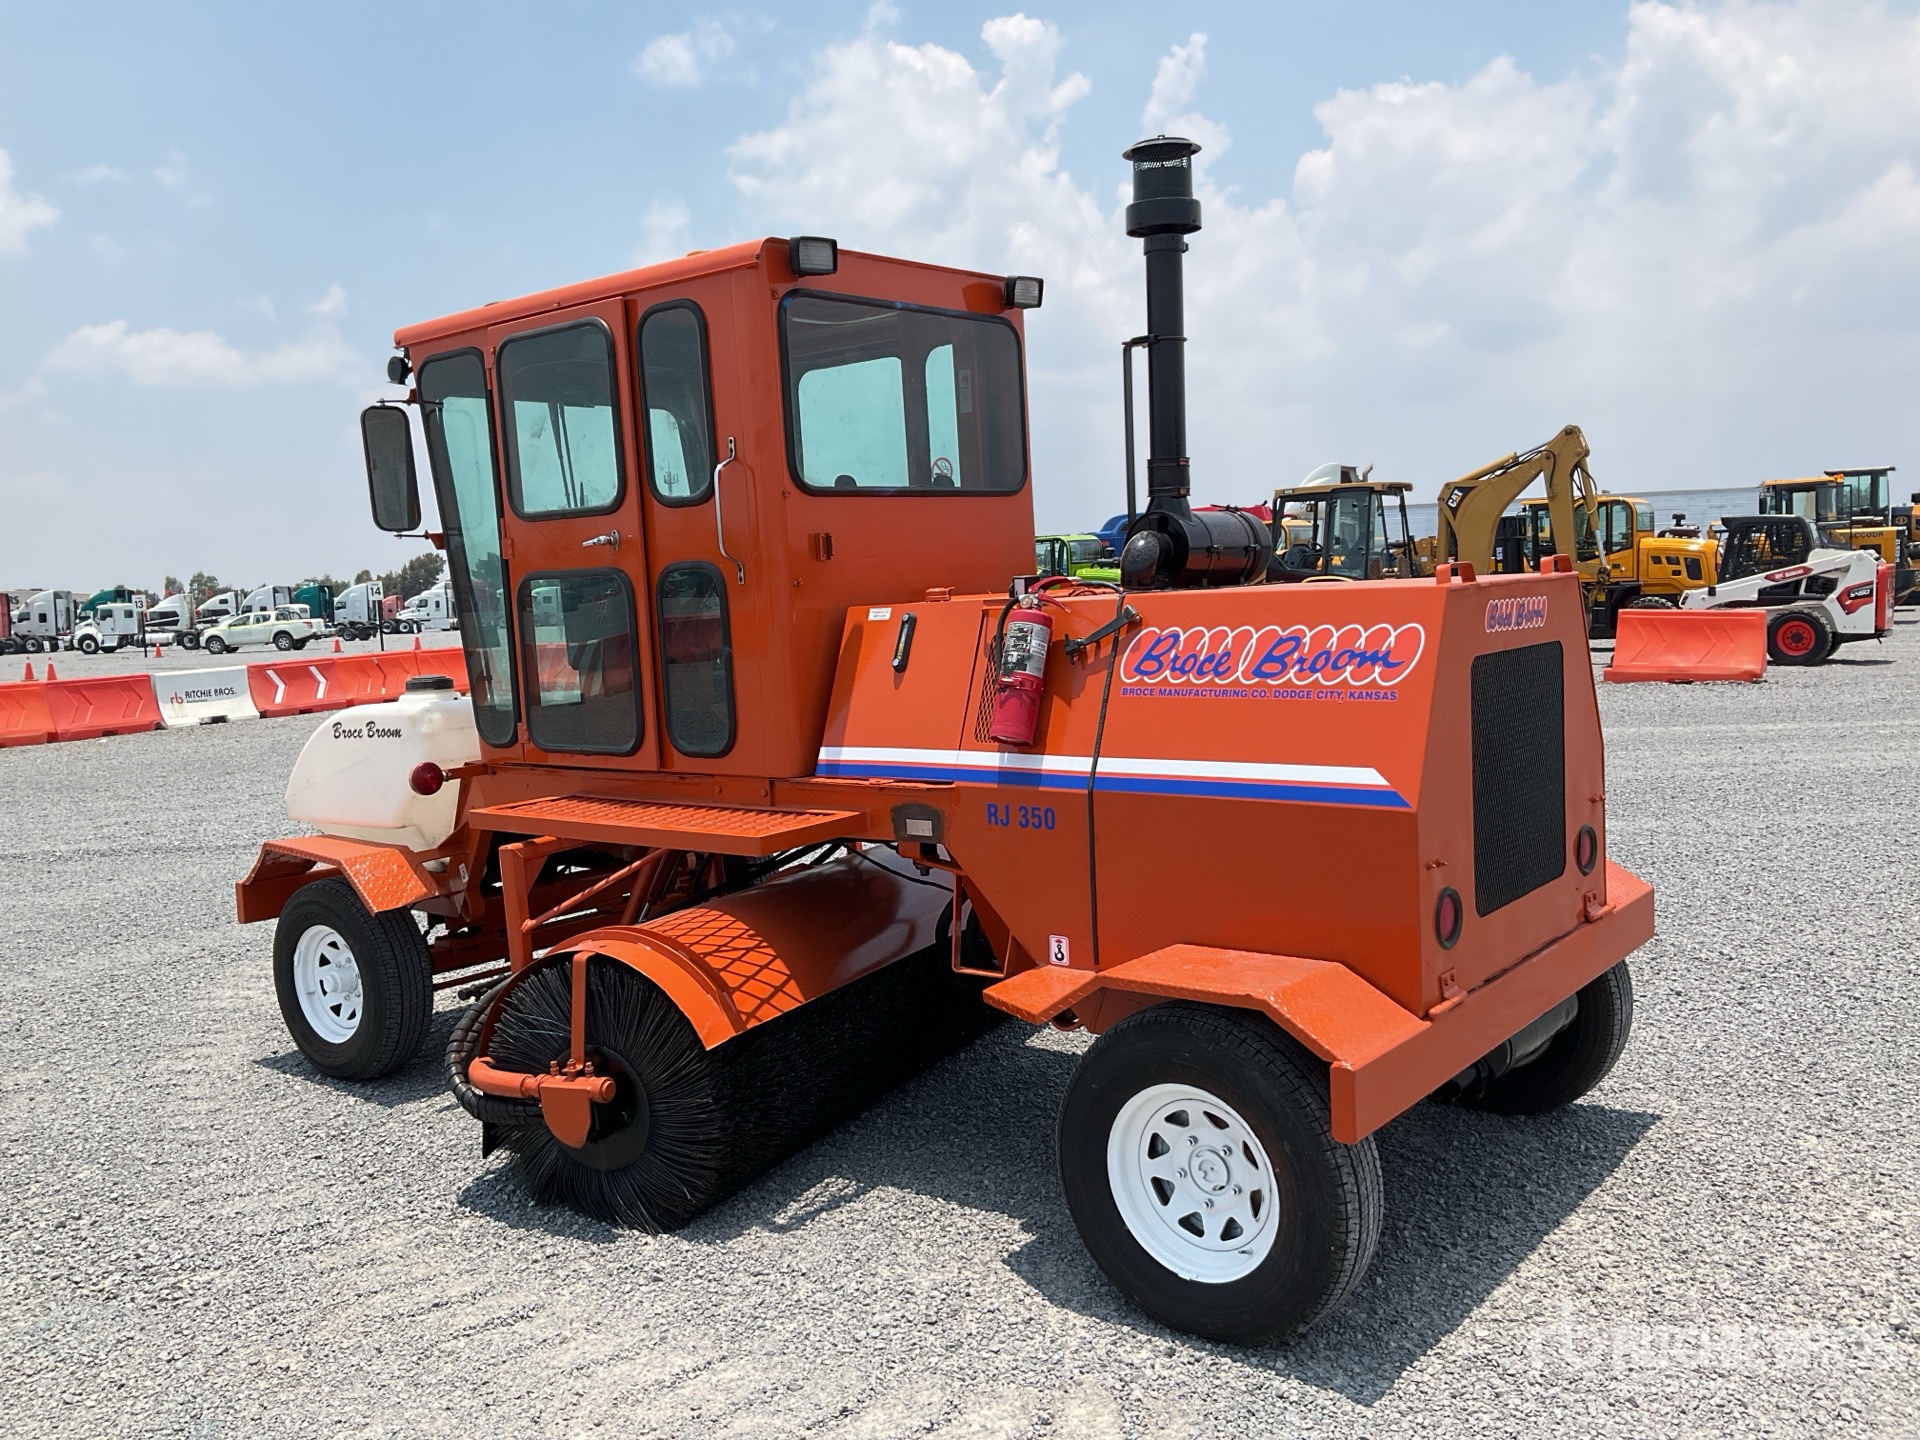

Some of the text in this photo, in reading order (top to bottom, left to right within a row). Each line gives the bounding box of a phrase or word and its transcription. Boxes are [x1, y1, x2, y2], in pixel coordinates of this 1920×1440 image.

[1447, 489, 1463, 508] CAT
[370, 586, 382, 597] 14
[134, 599, 144, 609] 13
[1132, 632, 1405, 680] Broce Broom
[185, 689, 212, 699] RITCHIE
[213, 686, 237, 697] BROS.
[1121, 687, 1398, 702] BROCE MANUFACTURING CO. DODGE CITY, KANSAS
[331, 720, 403, 739] Broce Broom
[986, 803, 1056, 831] RJ 350
